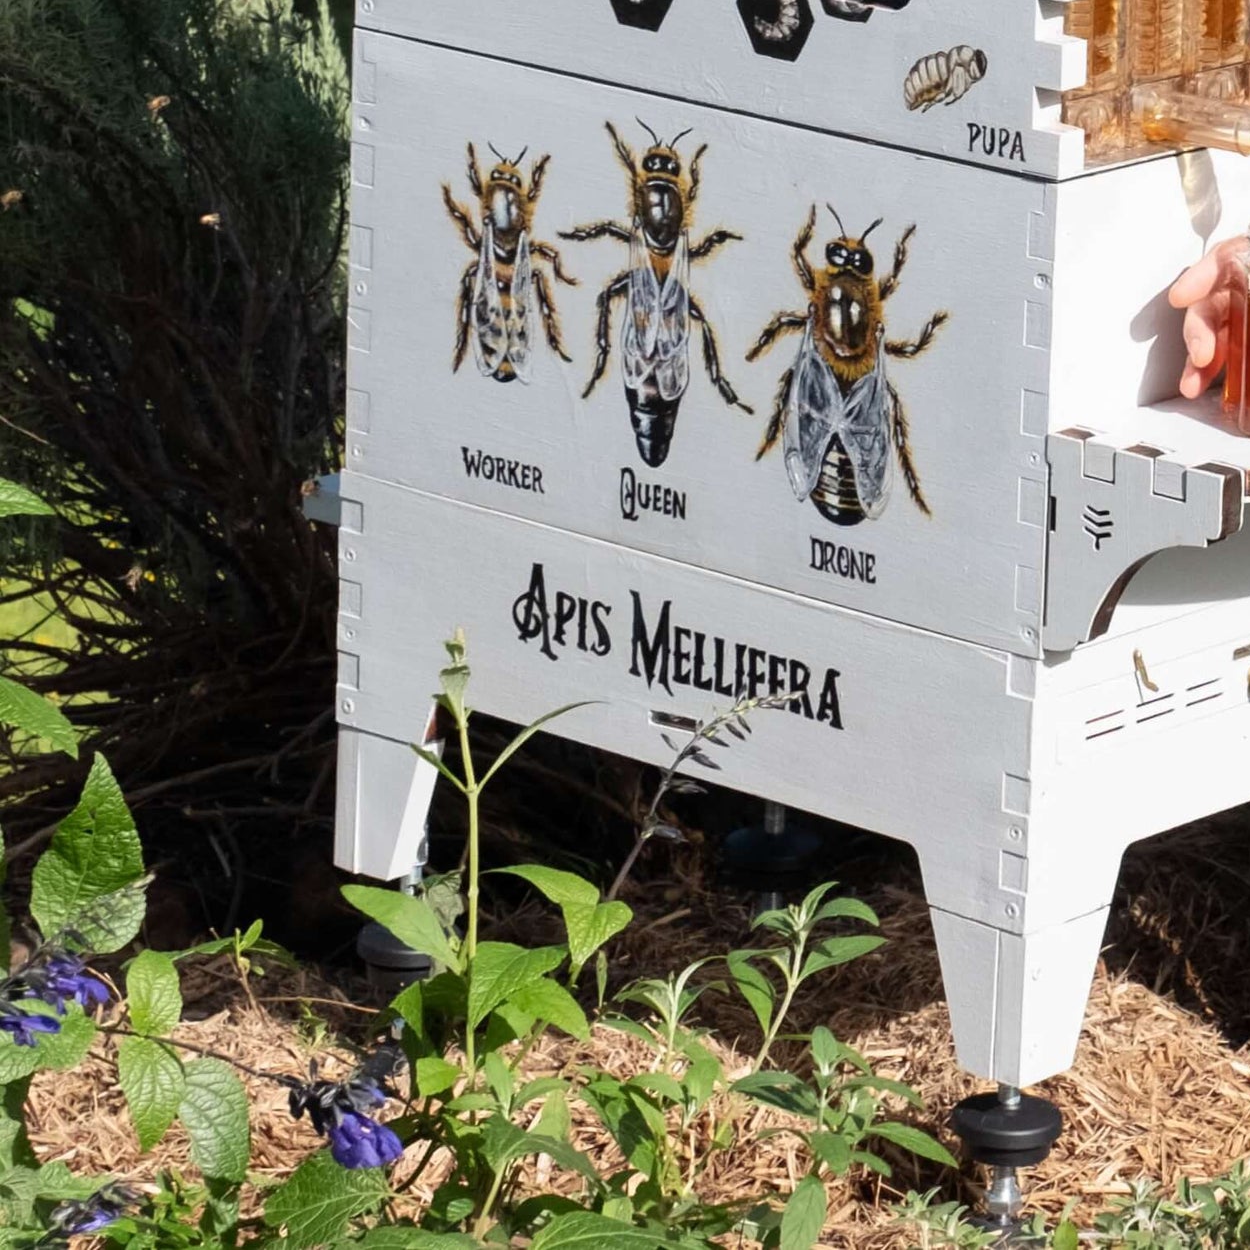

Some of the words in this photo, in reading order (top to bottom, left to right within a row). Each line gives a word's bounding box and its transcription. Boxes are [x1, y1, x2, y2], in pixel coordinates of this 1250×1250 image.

[967, 122, 1026, 162] PUPA
[461, 446, 545, 494] WORKER
[620, 467, 686, 521] QUEEN
[809, 534, 876, 584] DRONE
[512, 562, 612, 661] APIS
